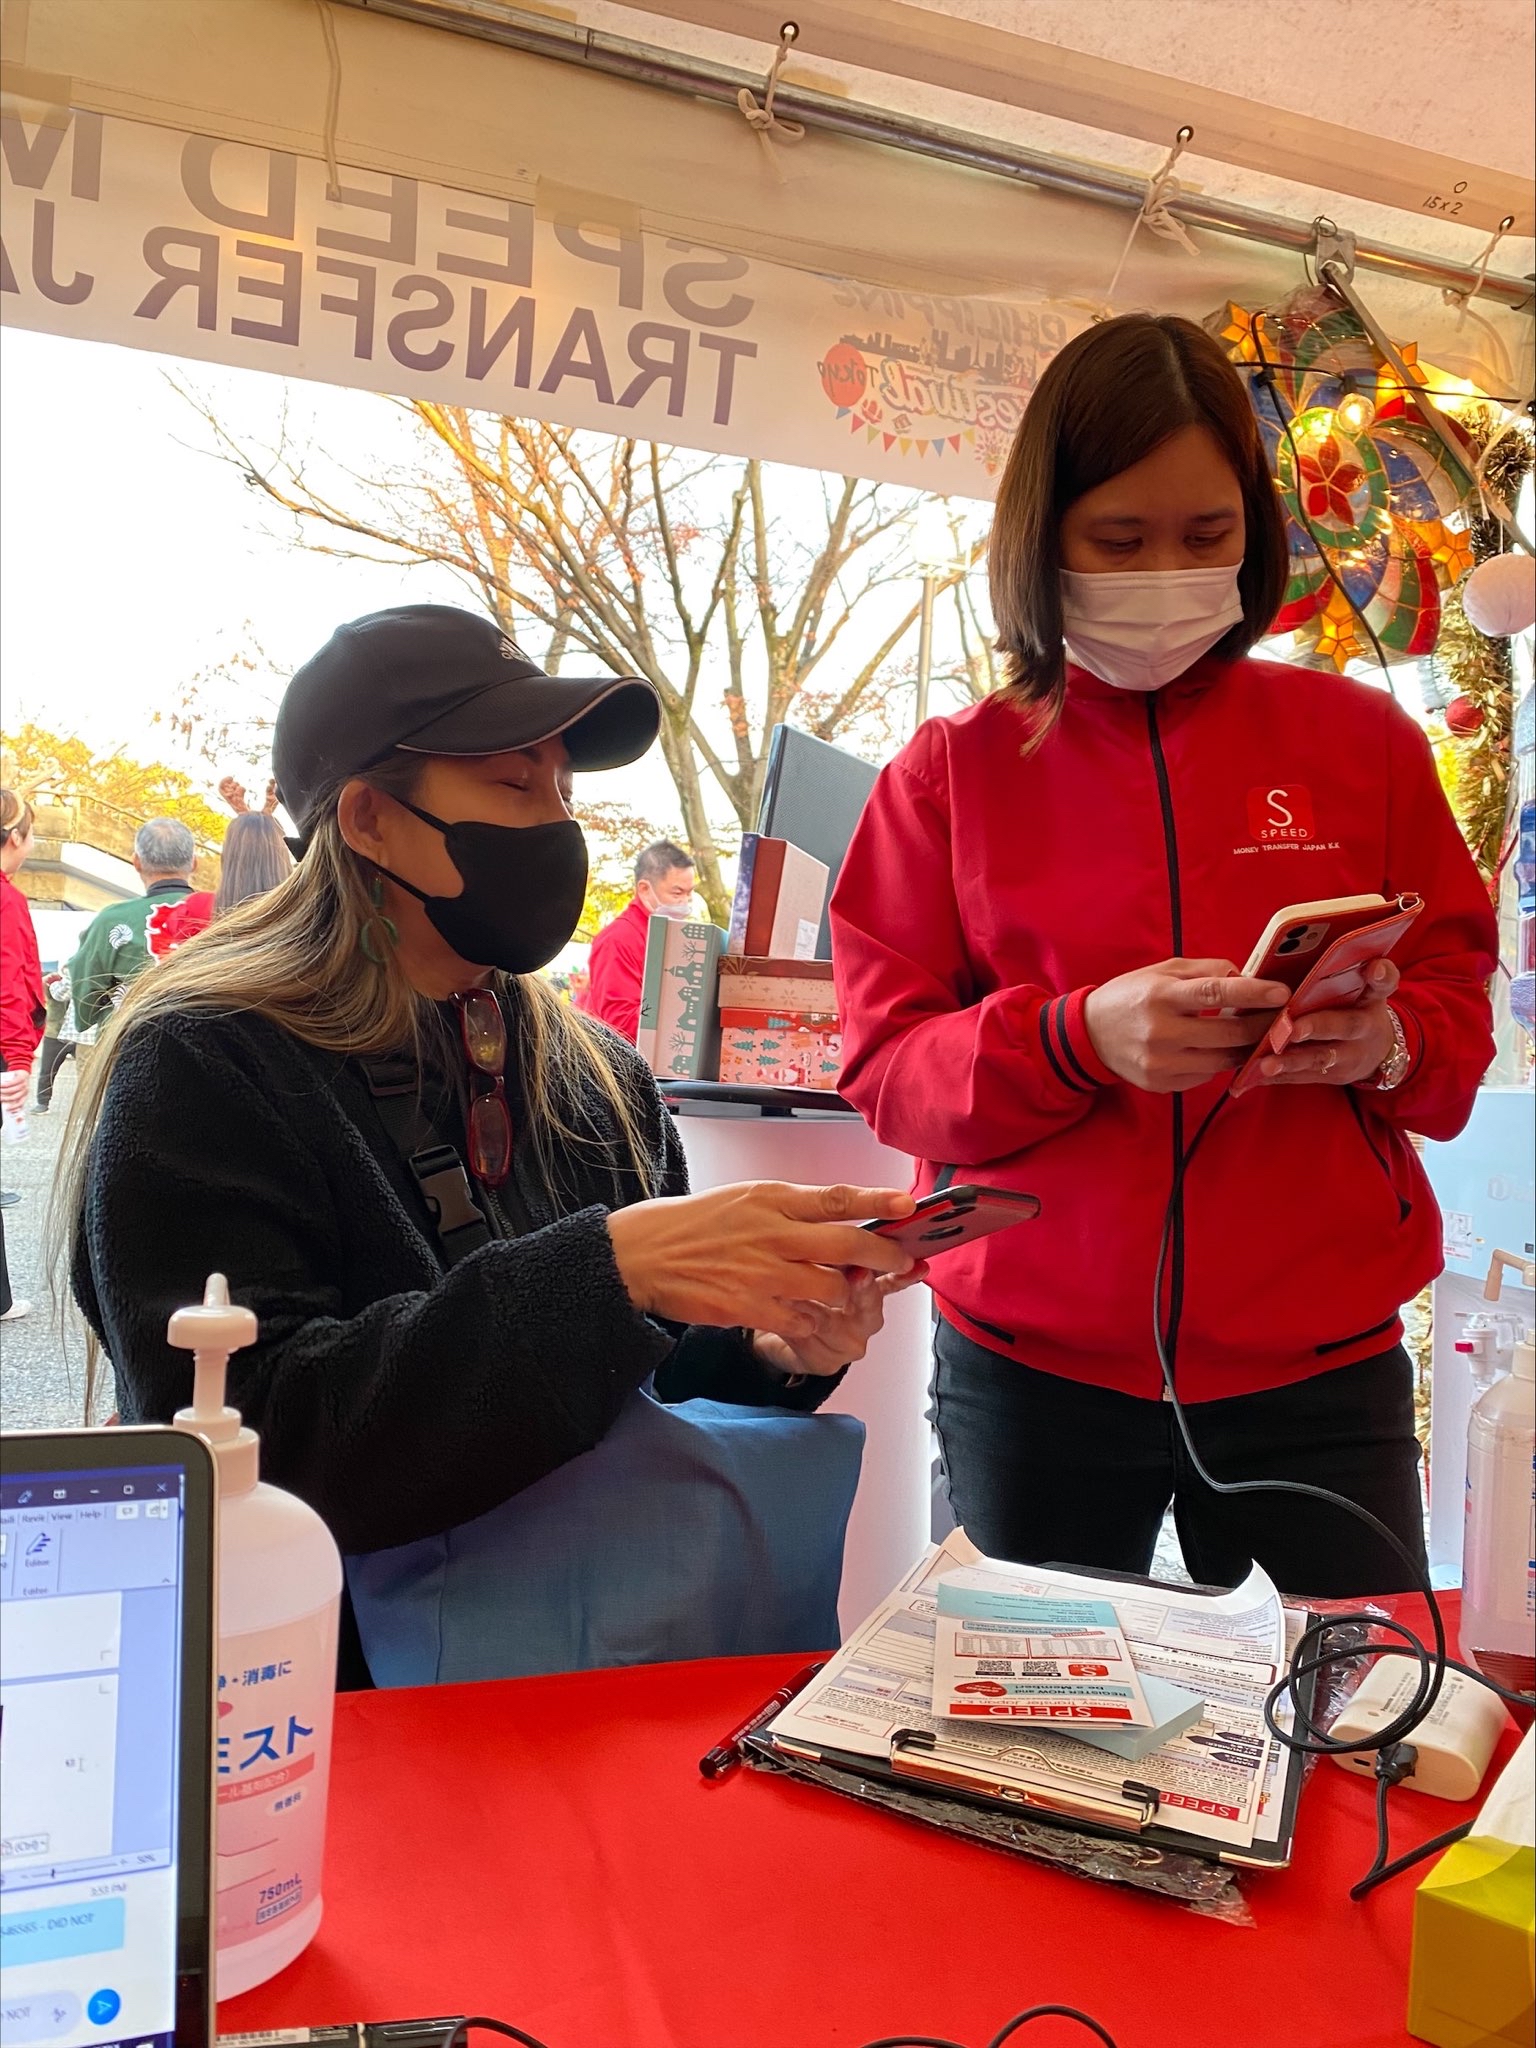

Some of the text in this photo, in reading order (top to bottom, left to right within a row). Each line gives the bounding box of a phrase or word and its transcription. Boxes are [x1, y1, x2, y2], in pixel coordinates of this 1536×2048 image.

[1260, 828, 1308, 838] SPEED
[1262, 843, 1300, 851] TRANSFER
[1082, 1700, 1129, 1708] Money
[988, 1706, 1092, 1718] SPEED
[259, 1872, 302, 1904] 750mL
